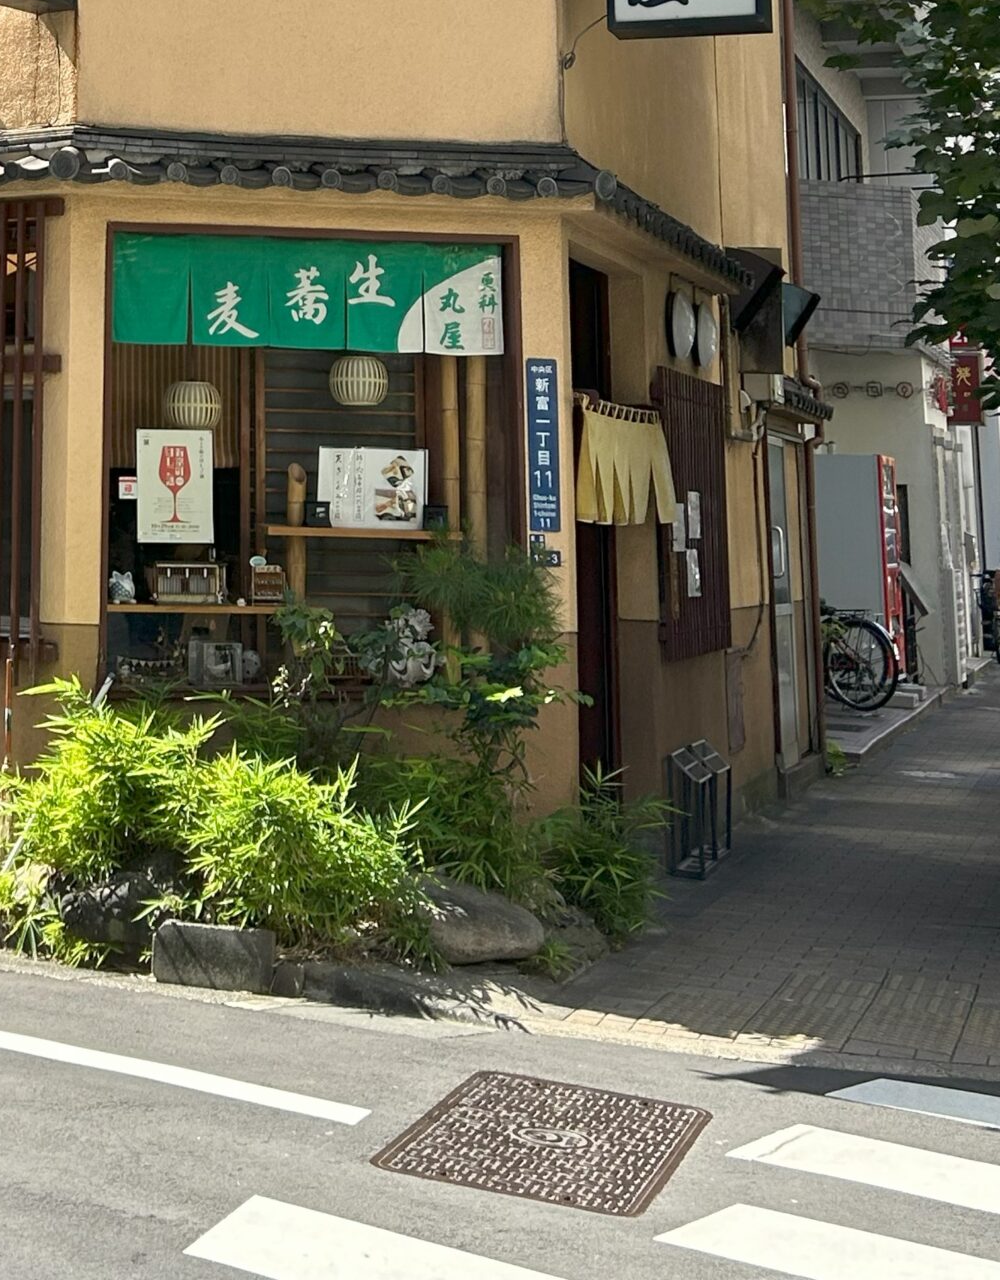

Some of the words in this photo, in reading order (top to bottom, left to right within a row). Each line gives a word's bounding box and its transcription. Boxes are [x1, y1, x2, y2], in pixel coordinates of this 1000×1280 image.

[478, 271, 498, 315] 更科
[439, 287, 466, 350] 丸屋
[535, 377, 551, 466] 新富一丁目
[533, 470, 553, 488] 11
[539, 517, 552, 529] 11
